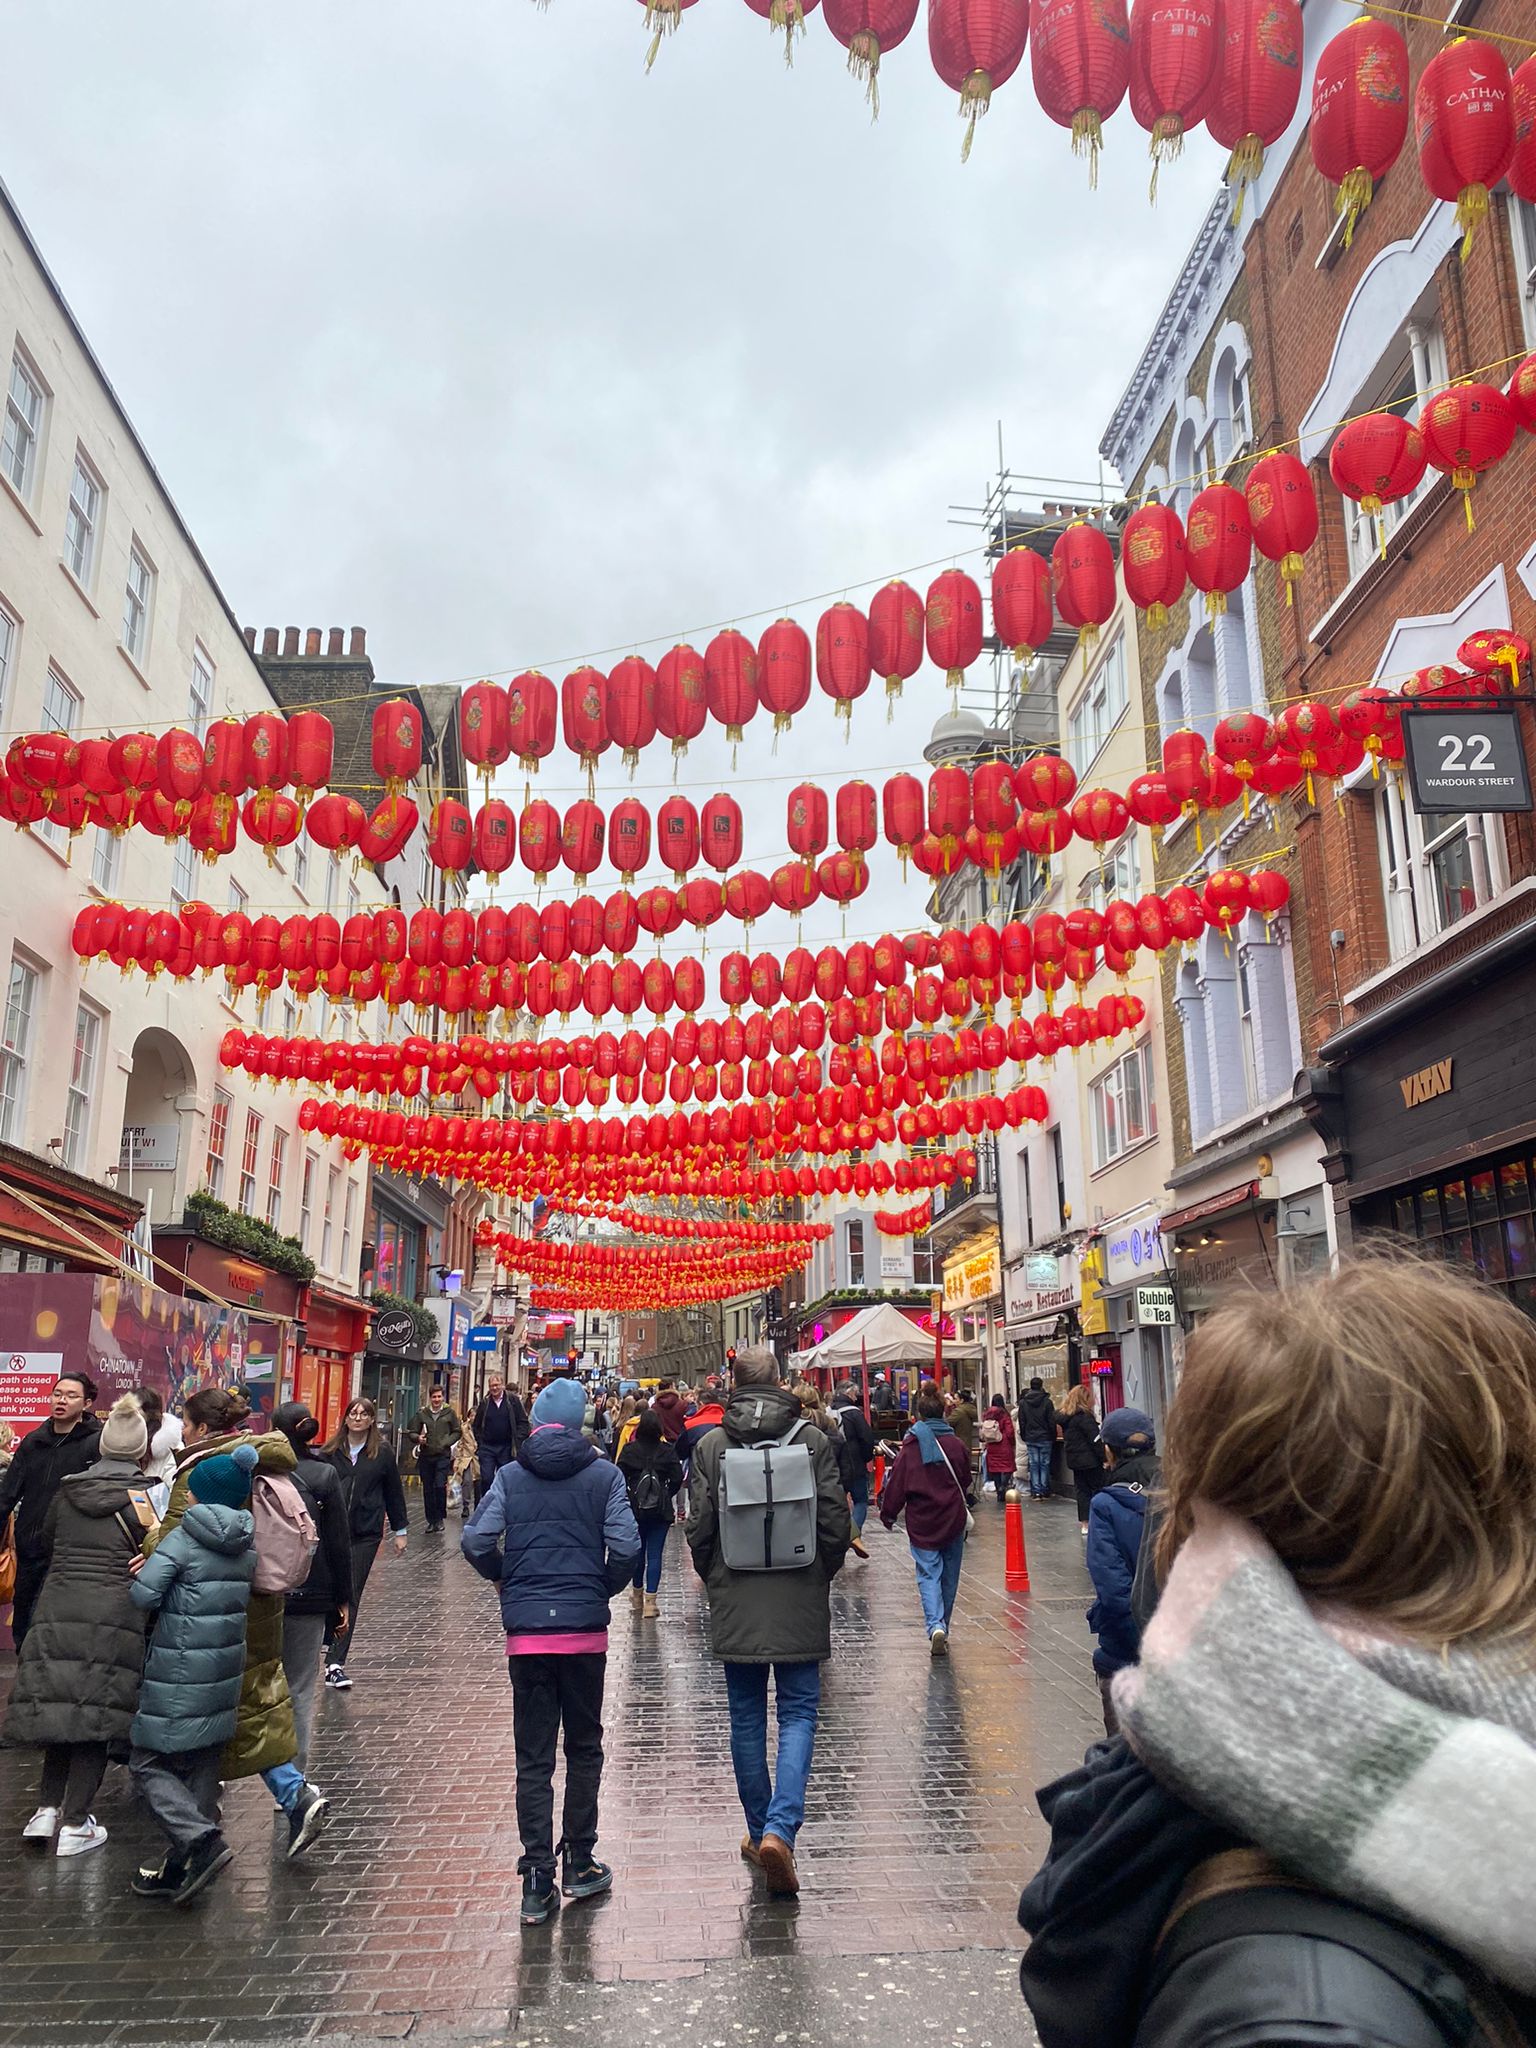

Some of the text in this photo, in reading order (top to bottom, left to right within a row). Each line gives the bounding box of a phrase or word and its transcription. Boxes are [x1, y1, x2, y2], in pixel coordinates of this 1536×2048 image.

[1152, 8, 1212, 27] CATHAY
[1446, 87, 1506, 106] CATHAY
[1438, 735, 1496, 771] 22
[1426, 777, 1515, 787] WARDOUR STREET
[142, 1139, 156, 1147] W1
[1036, 1283, 1074, 1311] Restaurant
[1139, 1291, 1175, 1306] Bubble
[1154, 1308, 1171, 1322] Tea
[100, 1358, 136, 1374] CHINATOWN
[22, 1376, 52, 1384] closed
[116, 1378, 133, 1389] LONDON
[19, 1407, 36, 1415] you
